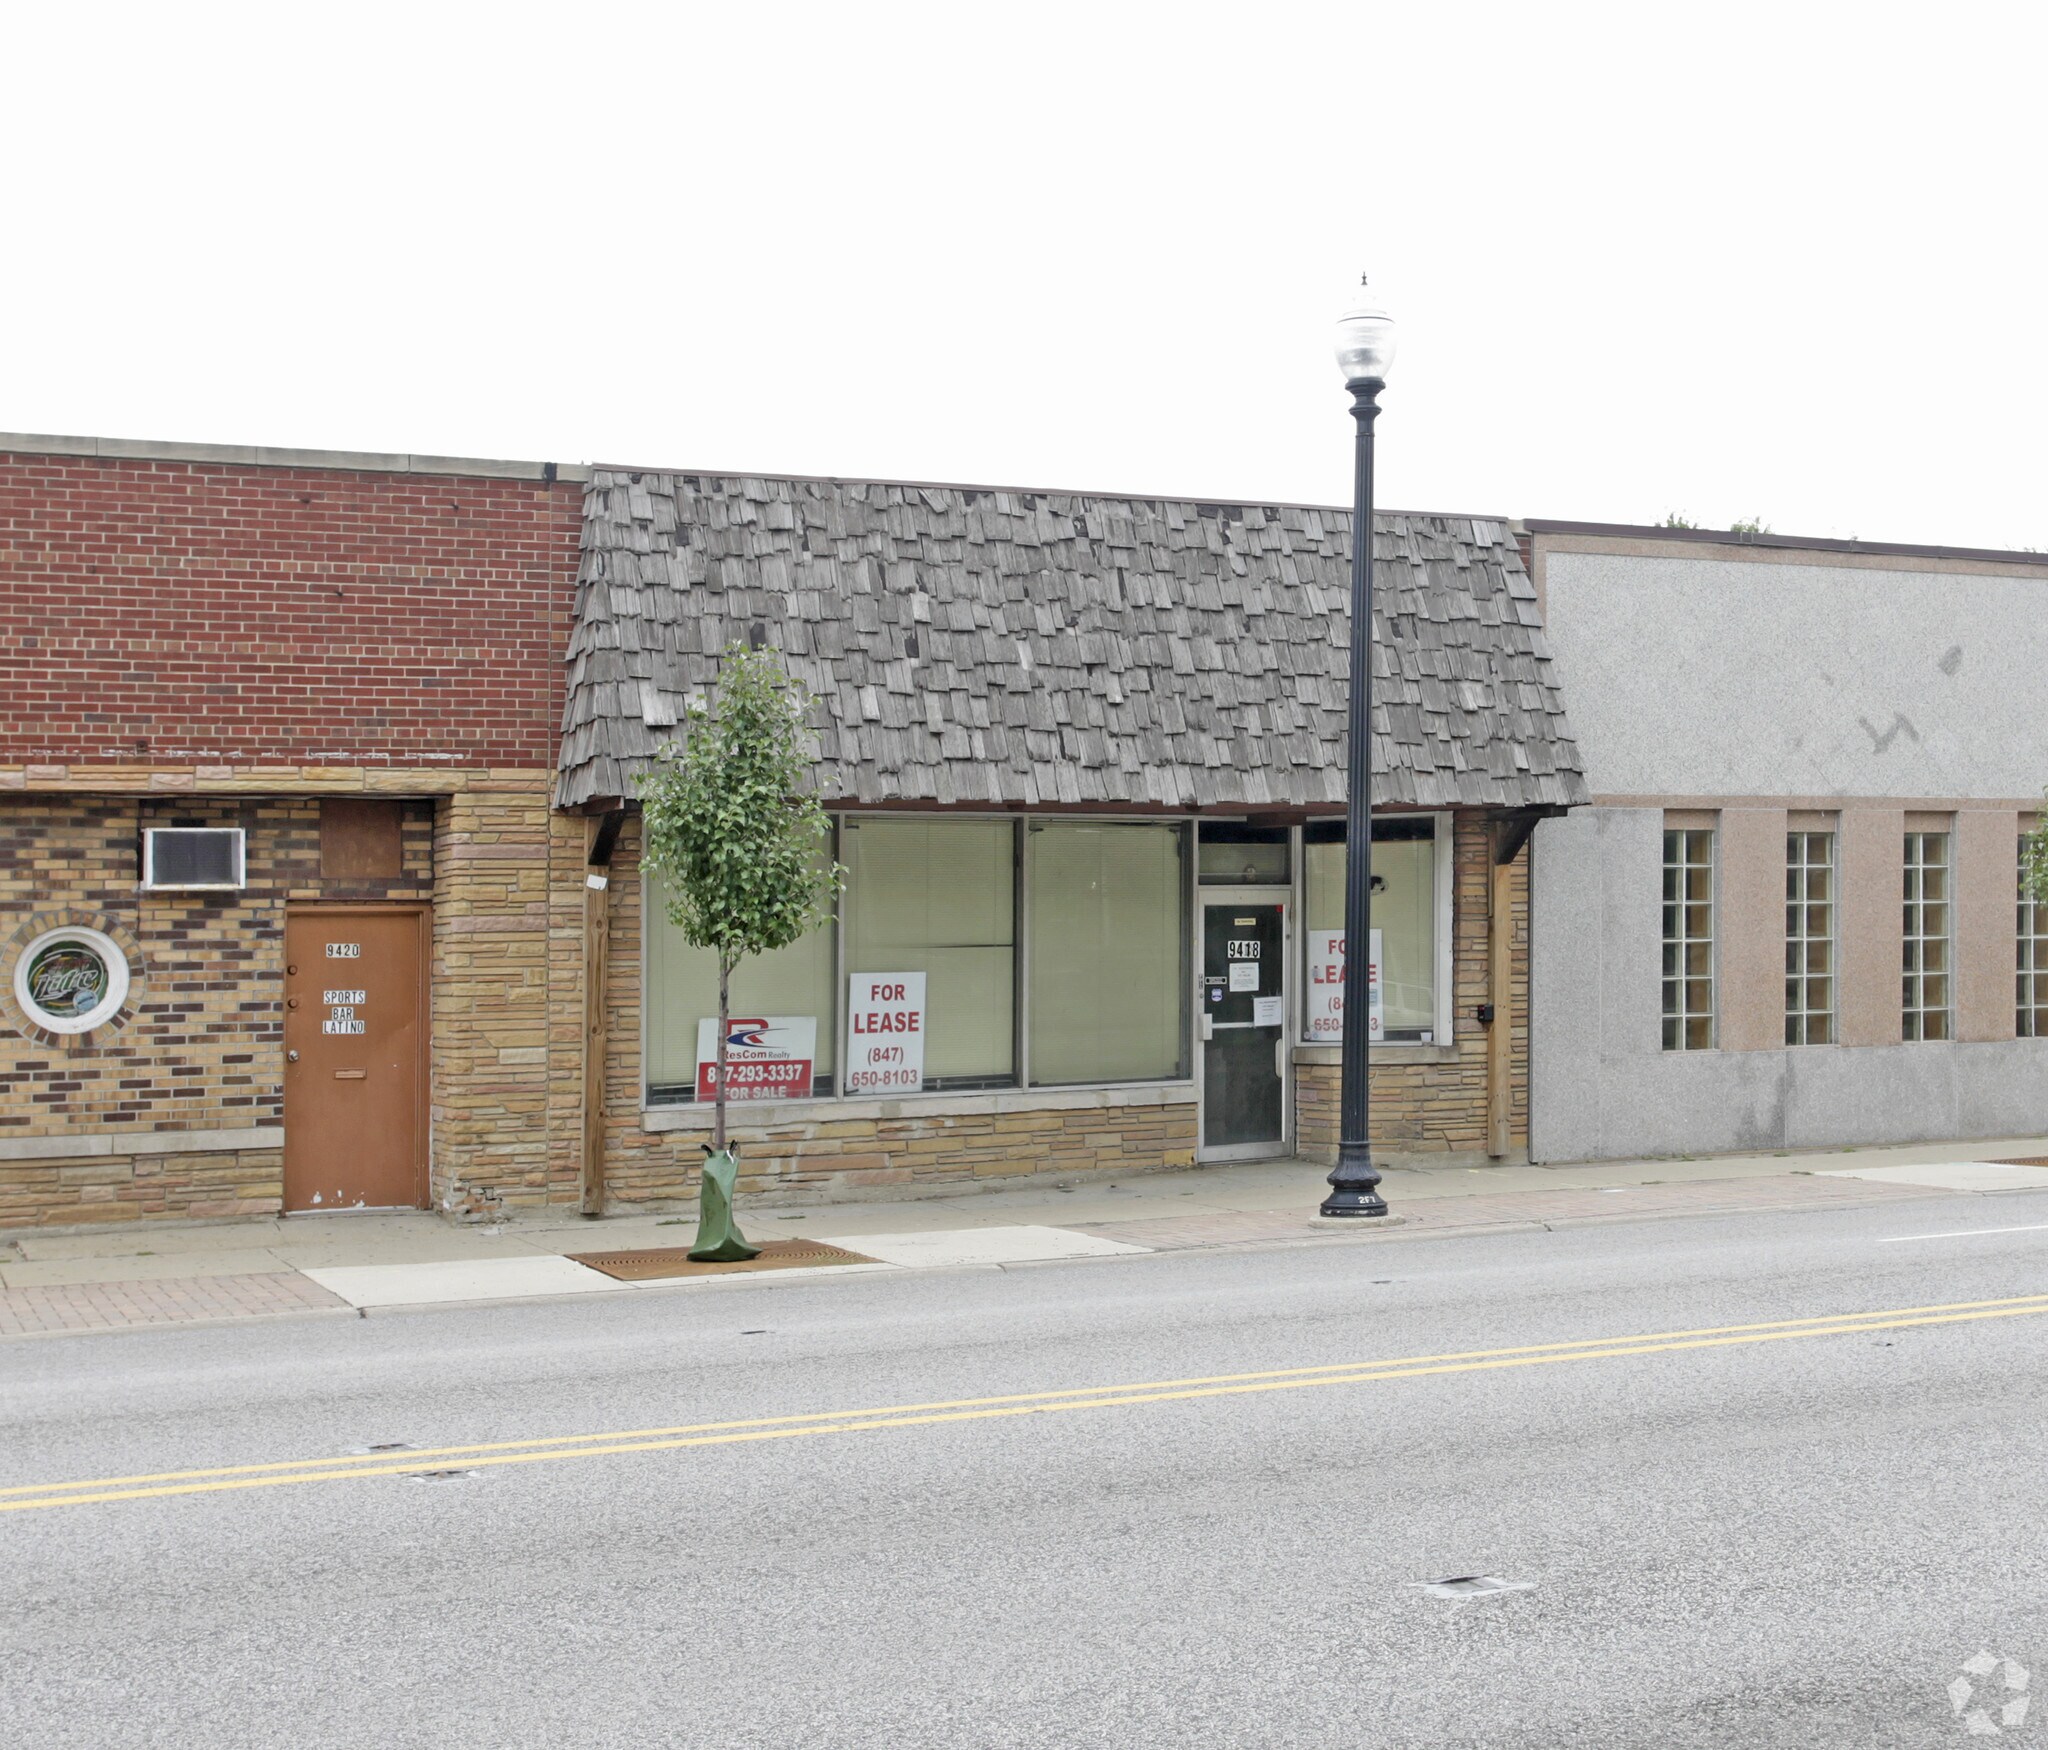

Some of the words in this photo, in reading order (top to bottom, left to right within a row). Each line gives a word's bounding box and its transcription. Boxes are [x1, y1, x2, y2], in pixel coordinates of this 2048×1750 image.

[327, 944, 359, 957] 9420
[1229, 941, 1259, 957] 9418
[1314, 964, 1377, 984] LEAE
[325, 991, 364, 1003] SPORTS
[871, 984, 905, 1001] FOR
[333, 1007, 353, 1020] BAR
[324, 1021, 363, 1034] LATINO
[854, 1012, 919, 1034] LEASE
[1314, 1018, 1378, 1031] 650-3
[867, 1047, 904, 1066] (847)
[707, 1064, 803, 1083] 87-293-3337
[852, 1069, 918, 1087] 650-8103
[752, 1086, 787, 1099] SALE
